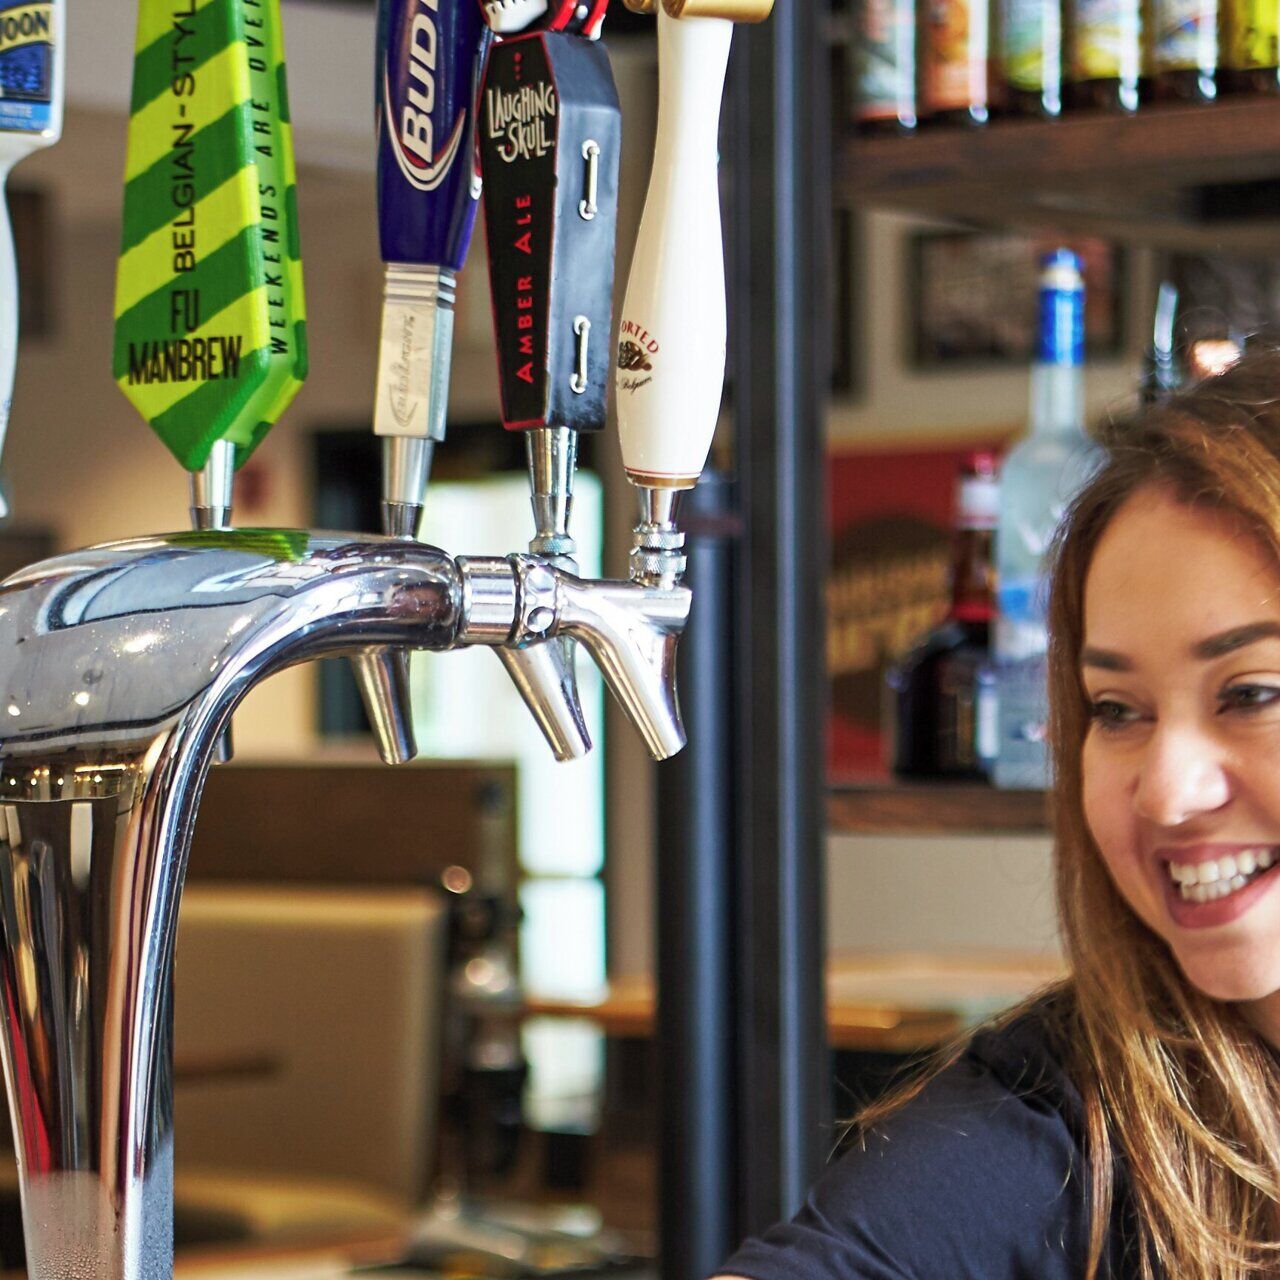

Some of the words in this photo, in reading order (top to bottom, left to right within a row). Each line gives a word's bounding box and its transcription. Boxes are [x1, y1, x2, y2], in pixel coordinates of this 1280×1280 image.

[402, 13, 438, 164] BUD
[486, 81, 557, 139] LAUGHING
[251, 99, 273, 158] ARE
[514, 194, 533, 254] ALE
[260, 183, 289, 355] WEEKENDS
[172, 288, 200, 334] FU
[516, 275, 535, 384] AMBER
[128, 335, 243, 386] MANBREW
